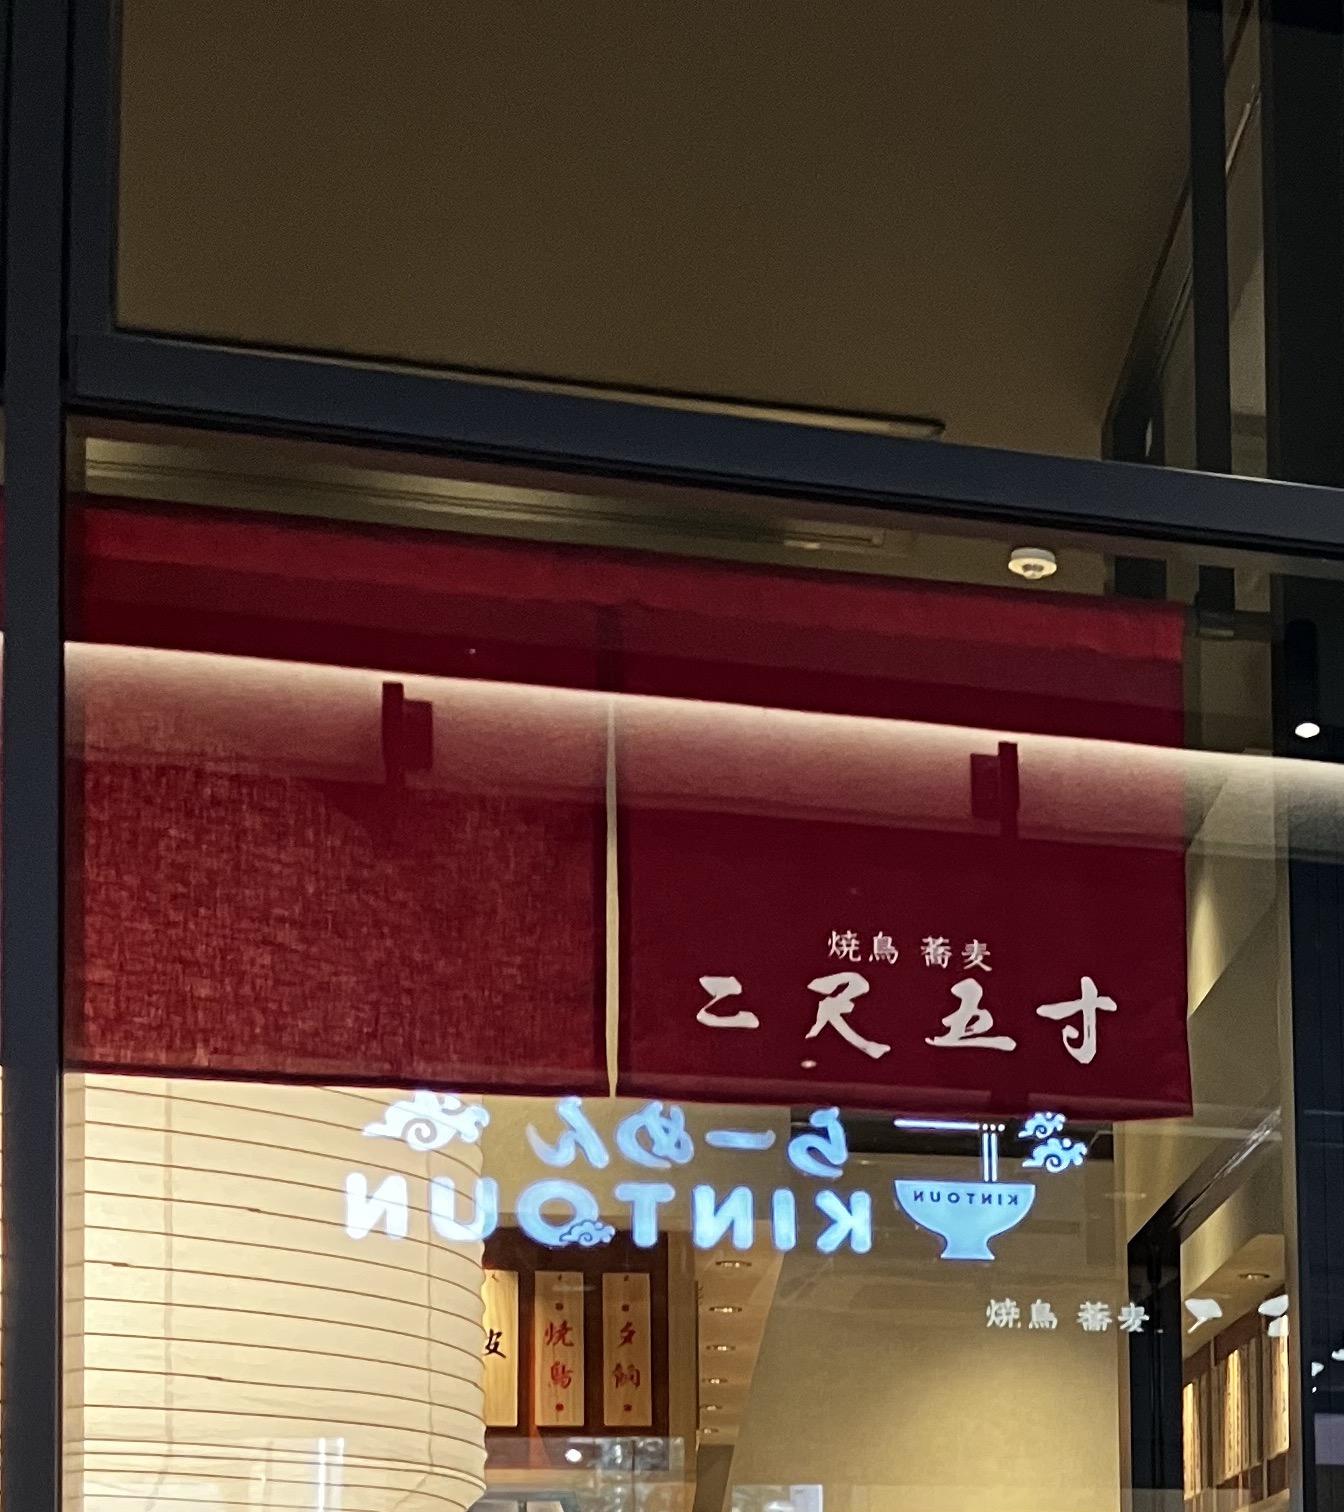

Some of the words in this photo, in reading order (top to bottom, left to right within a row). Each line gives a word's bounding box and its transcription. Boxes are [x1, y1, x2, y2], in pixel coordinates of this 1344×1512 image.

[828, 930, 899, 965] 焼鳥
[920, 936, 993, 972] 蕎麦
[696, 971, 1118, 1064] 二尺五寸
